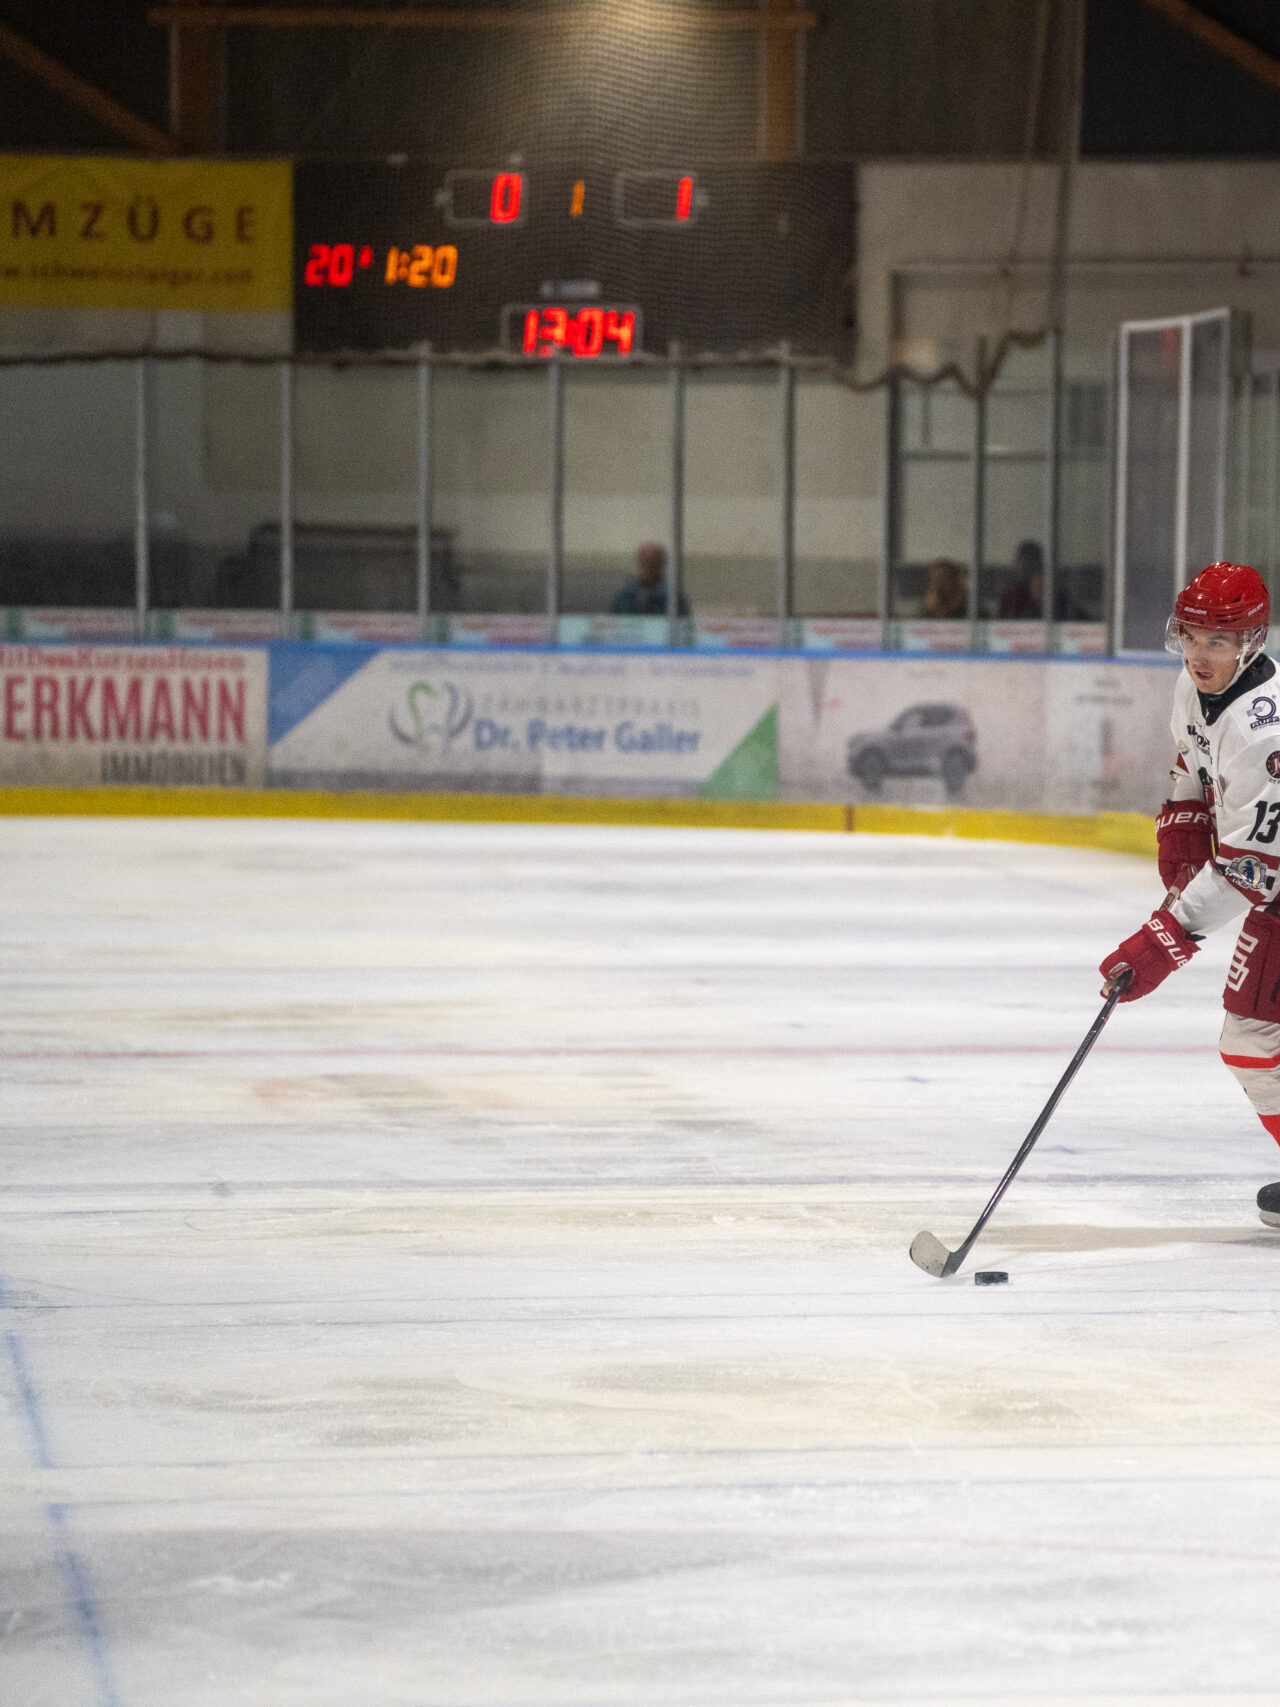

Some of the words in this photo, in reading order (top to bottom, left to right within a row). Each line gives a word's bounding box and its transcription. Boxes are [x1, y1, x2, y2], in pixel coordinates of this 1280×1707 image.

[490, 173, 522, 223] 0
[570, 180, 586, 217] 1
[676, 176, 692, 221] 1
[385, 244, 457, 288] 1:20
[523, 306, 635, 358] 13:04
[1184, 606, 1207, 616] BAUER
[4, 675, 246, 742] ERKMANN
[527, 719, 605, 753] Peter
